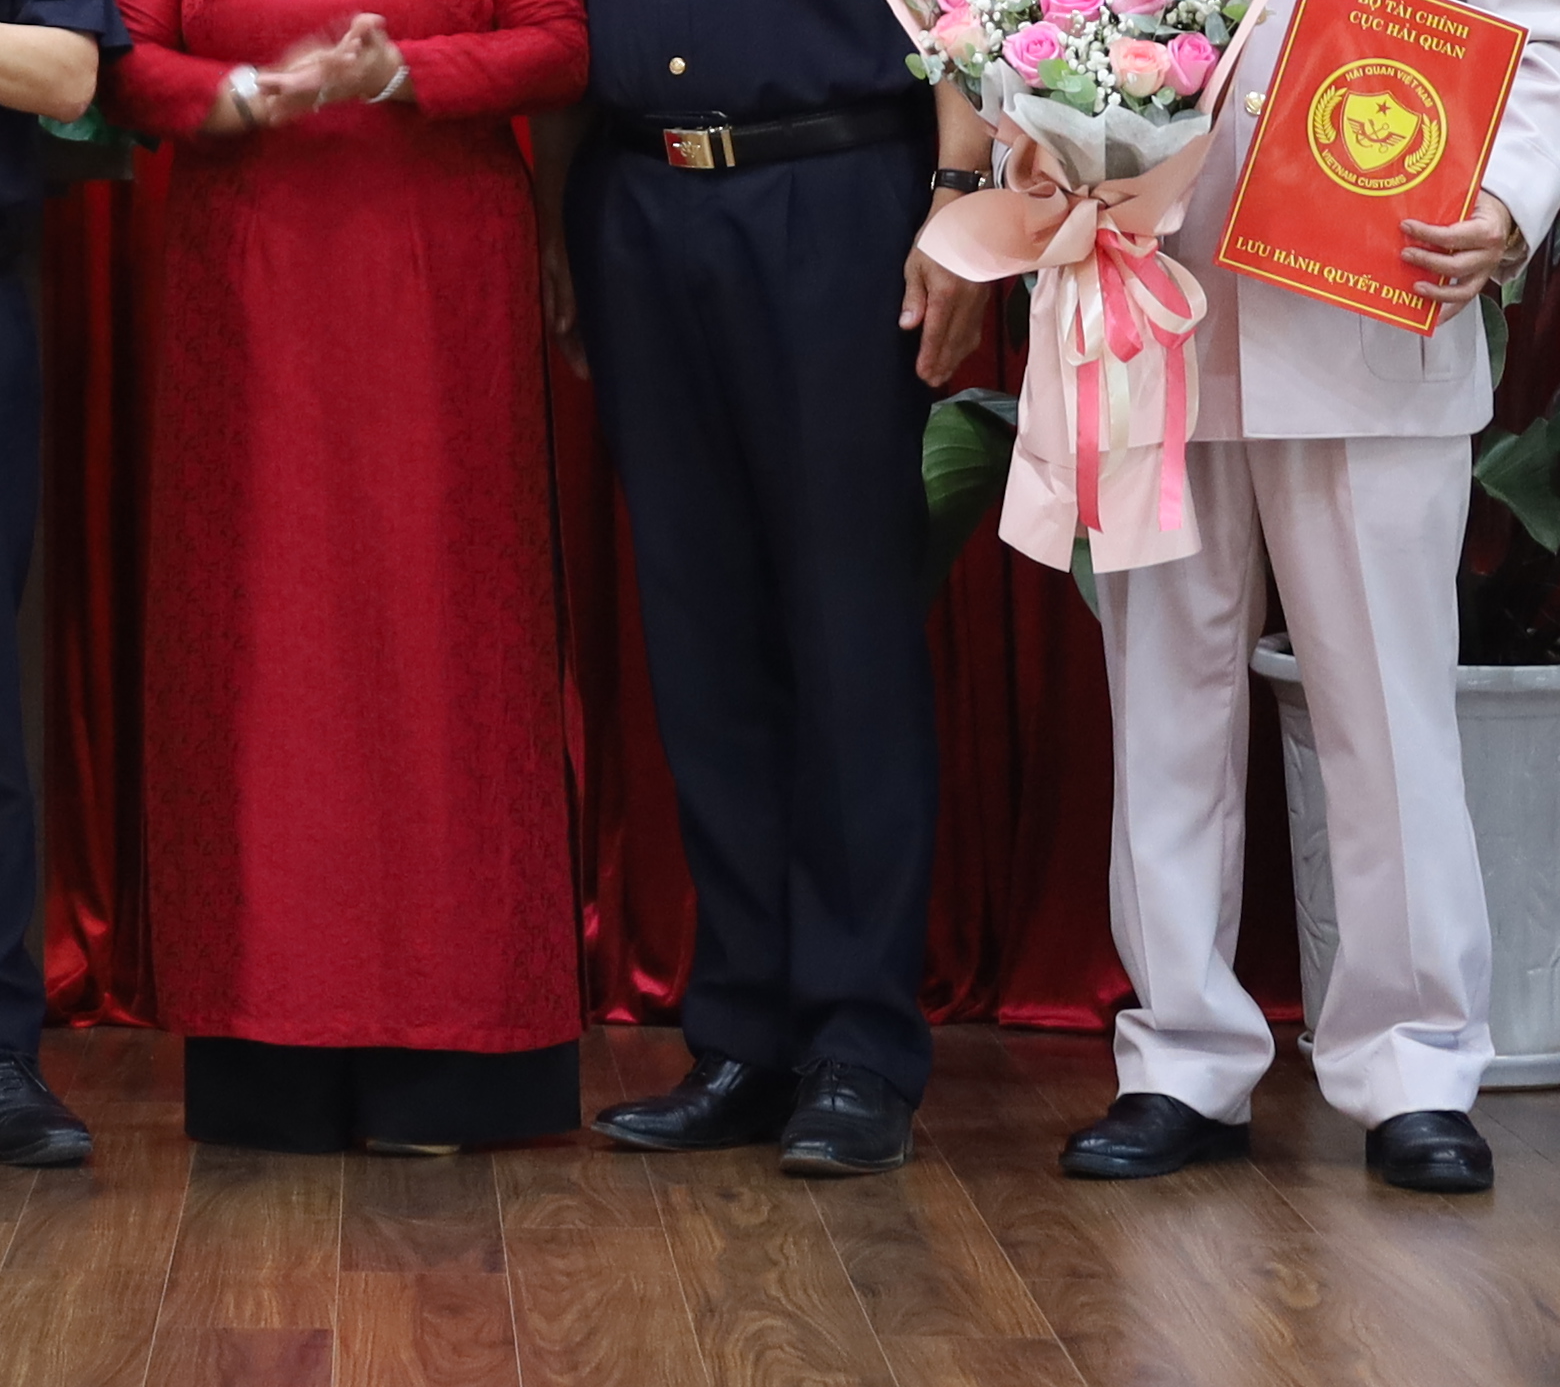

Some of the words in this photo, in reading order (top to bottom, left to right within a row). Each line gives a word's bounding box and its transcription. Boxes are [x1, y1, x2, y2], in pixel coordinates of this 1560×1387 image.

[1349, 10, 1384, 30] CỤC
[1419, 34, 1466, 60] QUAN
[1385, 0, 1413, 20] TÀI
[1415, 11, 1470, 39] CHÍNH
[1365, 66, 1395, 77] QUAN
[1416, 86, 1434, 108] NAM
[1321, 148, 1357, 183] VIETNAM
[1357, 173, 1407, 188] CUSTOMS
[1235, 236, 1271, 258] LƯU
[1272, 249, 1321, 276] HÀNH
[1323, 266, 1380, 295] QUYẾT
[1380, 284, 1424, 310] ĐỊNH
